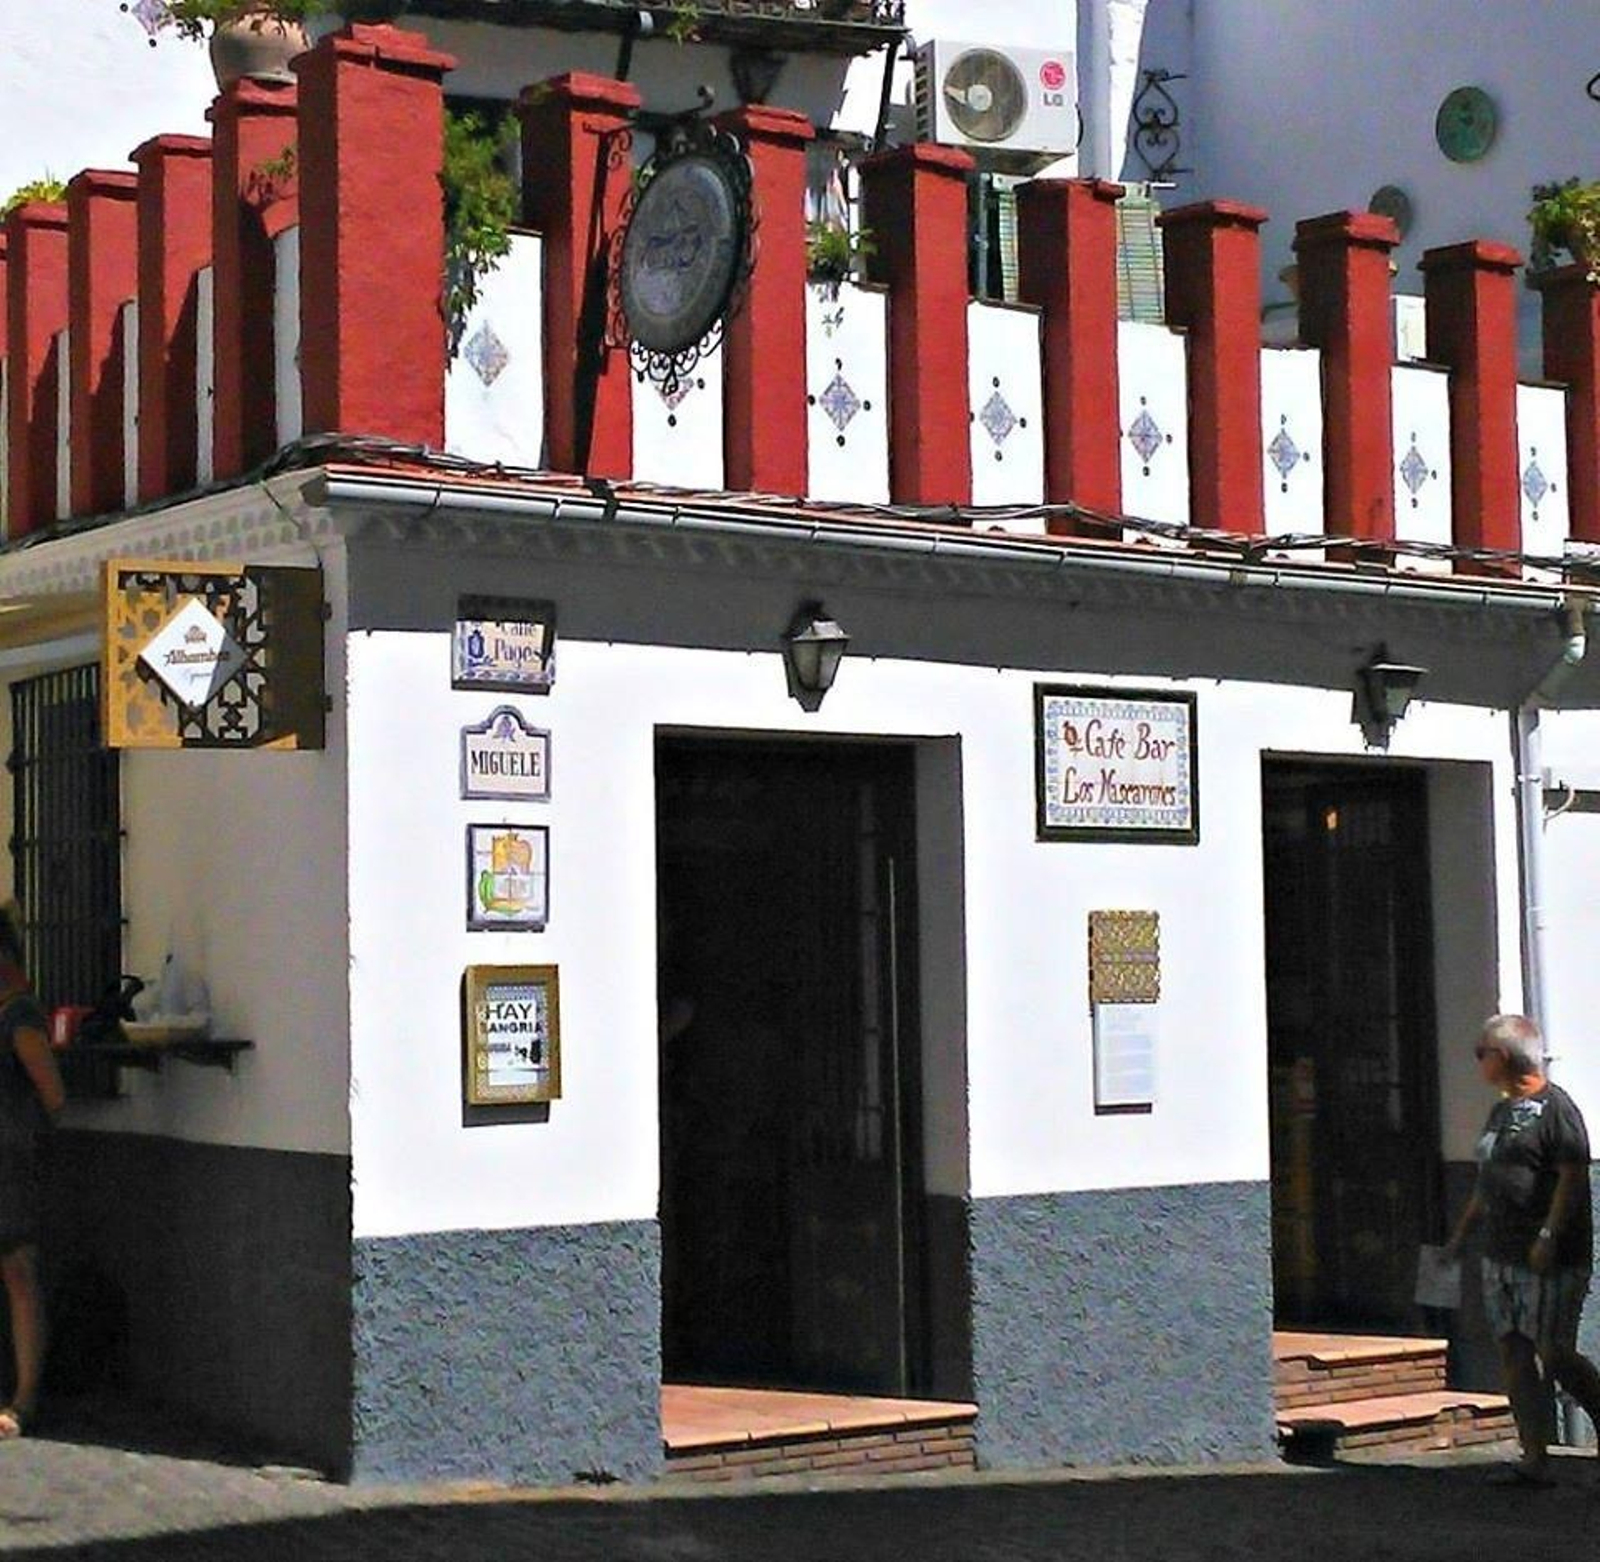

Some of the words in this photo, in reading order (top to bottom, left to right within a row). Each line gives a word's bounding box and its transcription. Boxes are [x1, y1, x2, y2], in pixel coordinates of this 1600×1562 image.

[1043, 93, 1064, 107] LG
[1134, 722, 1176, 762] Bar
[470, 750, 541, 777] MIGUELE
[1062, 766, 1094, 804] Los
[485, 1003, 532, 1020] HAY
